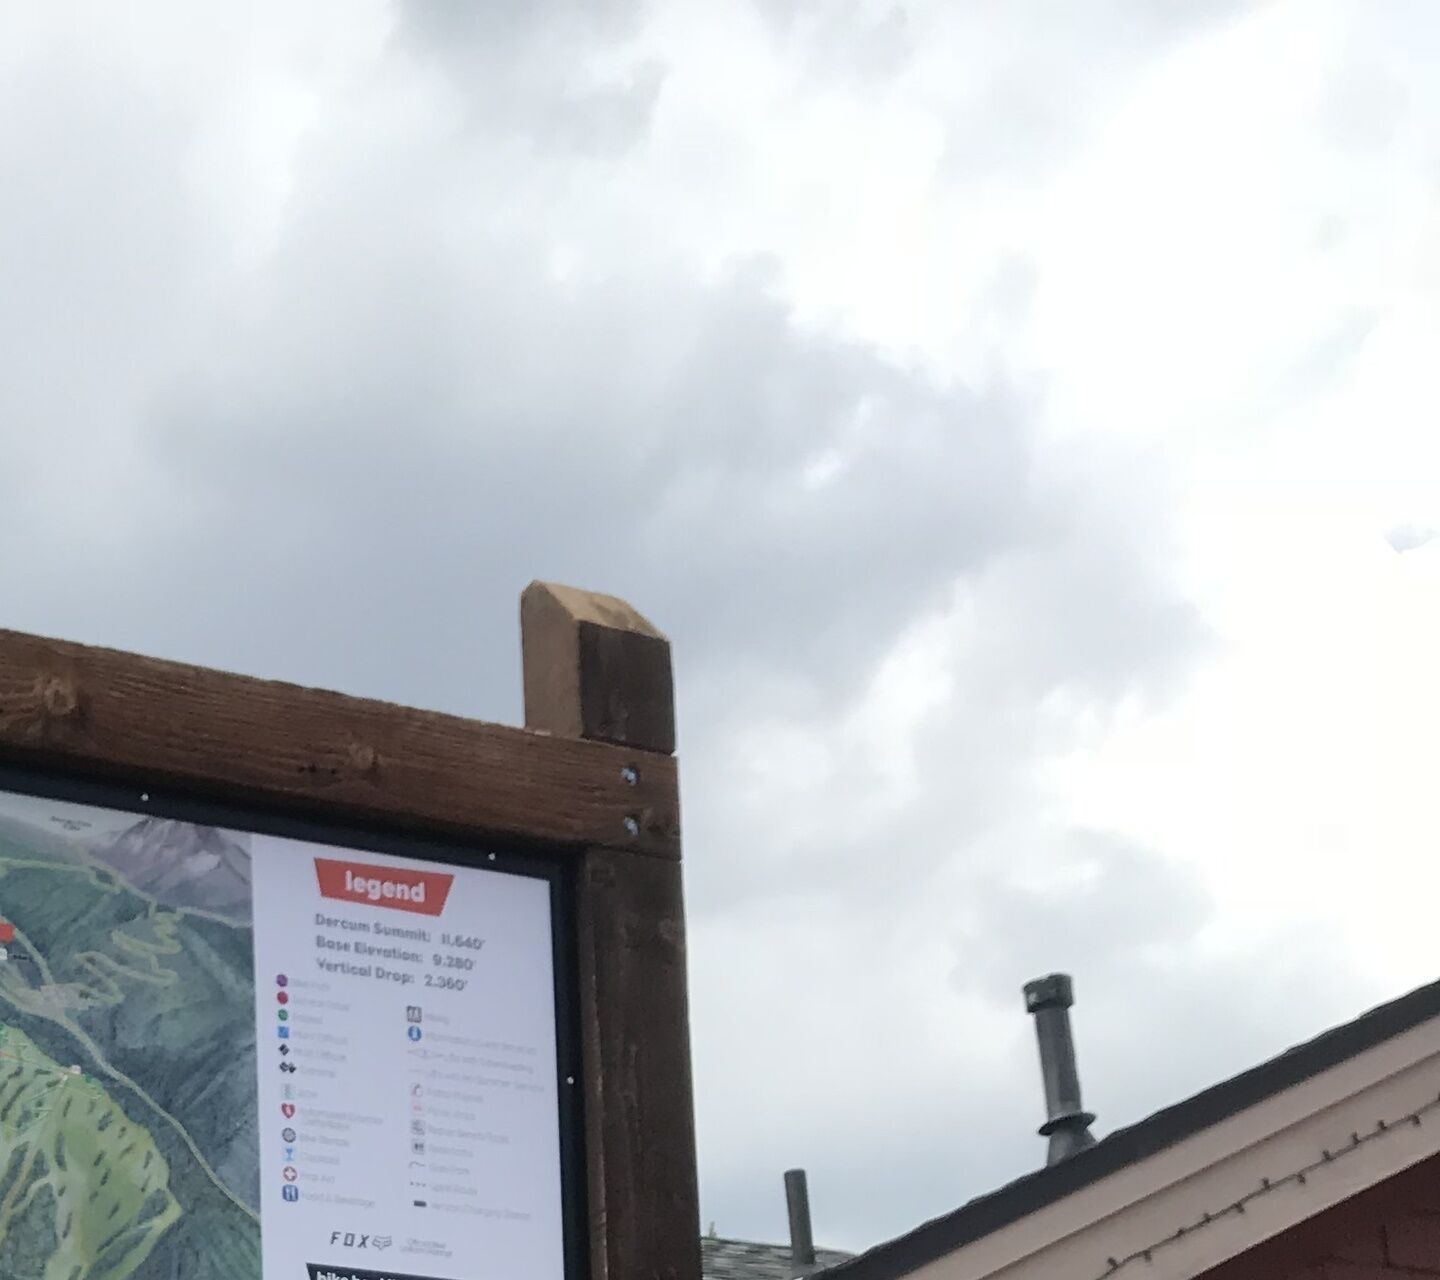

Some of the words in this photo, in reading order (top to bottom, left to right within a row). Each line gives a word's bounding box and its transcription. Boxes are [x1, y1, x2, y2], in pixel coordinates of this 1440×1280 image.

[345, 870, 426, 903] legend
[314, 913, 370, 932] Dercum
[373, 922, 431, 943] Summit:
[315, 935, 351, 952] Base
[353, 941, 424, 963] Elevation:
[316, 957, 372, 977] Vertical
[375, 966, 415, 986] Drop:
[329, 1231, 370, 1249] FOX
